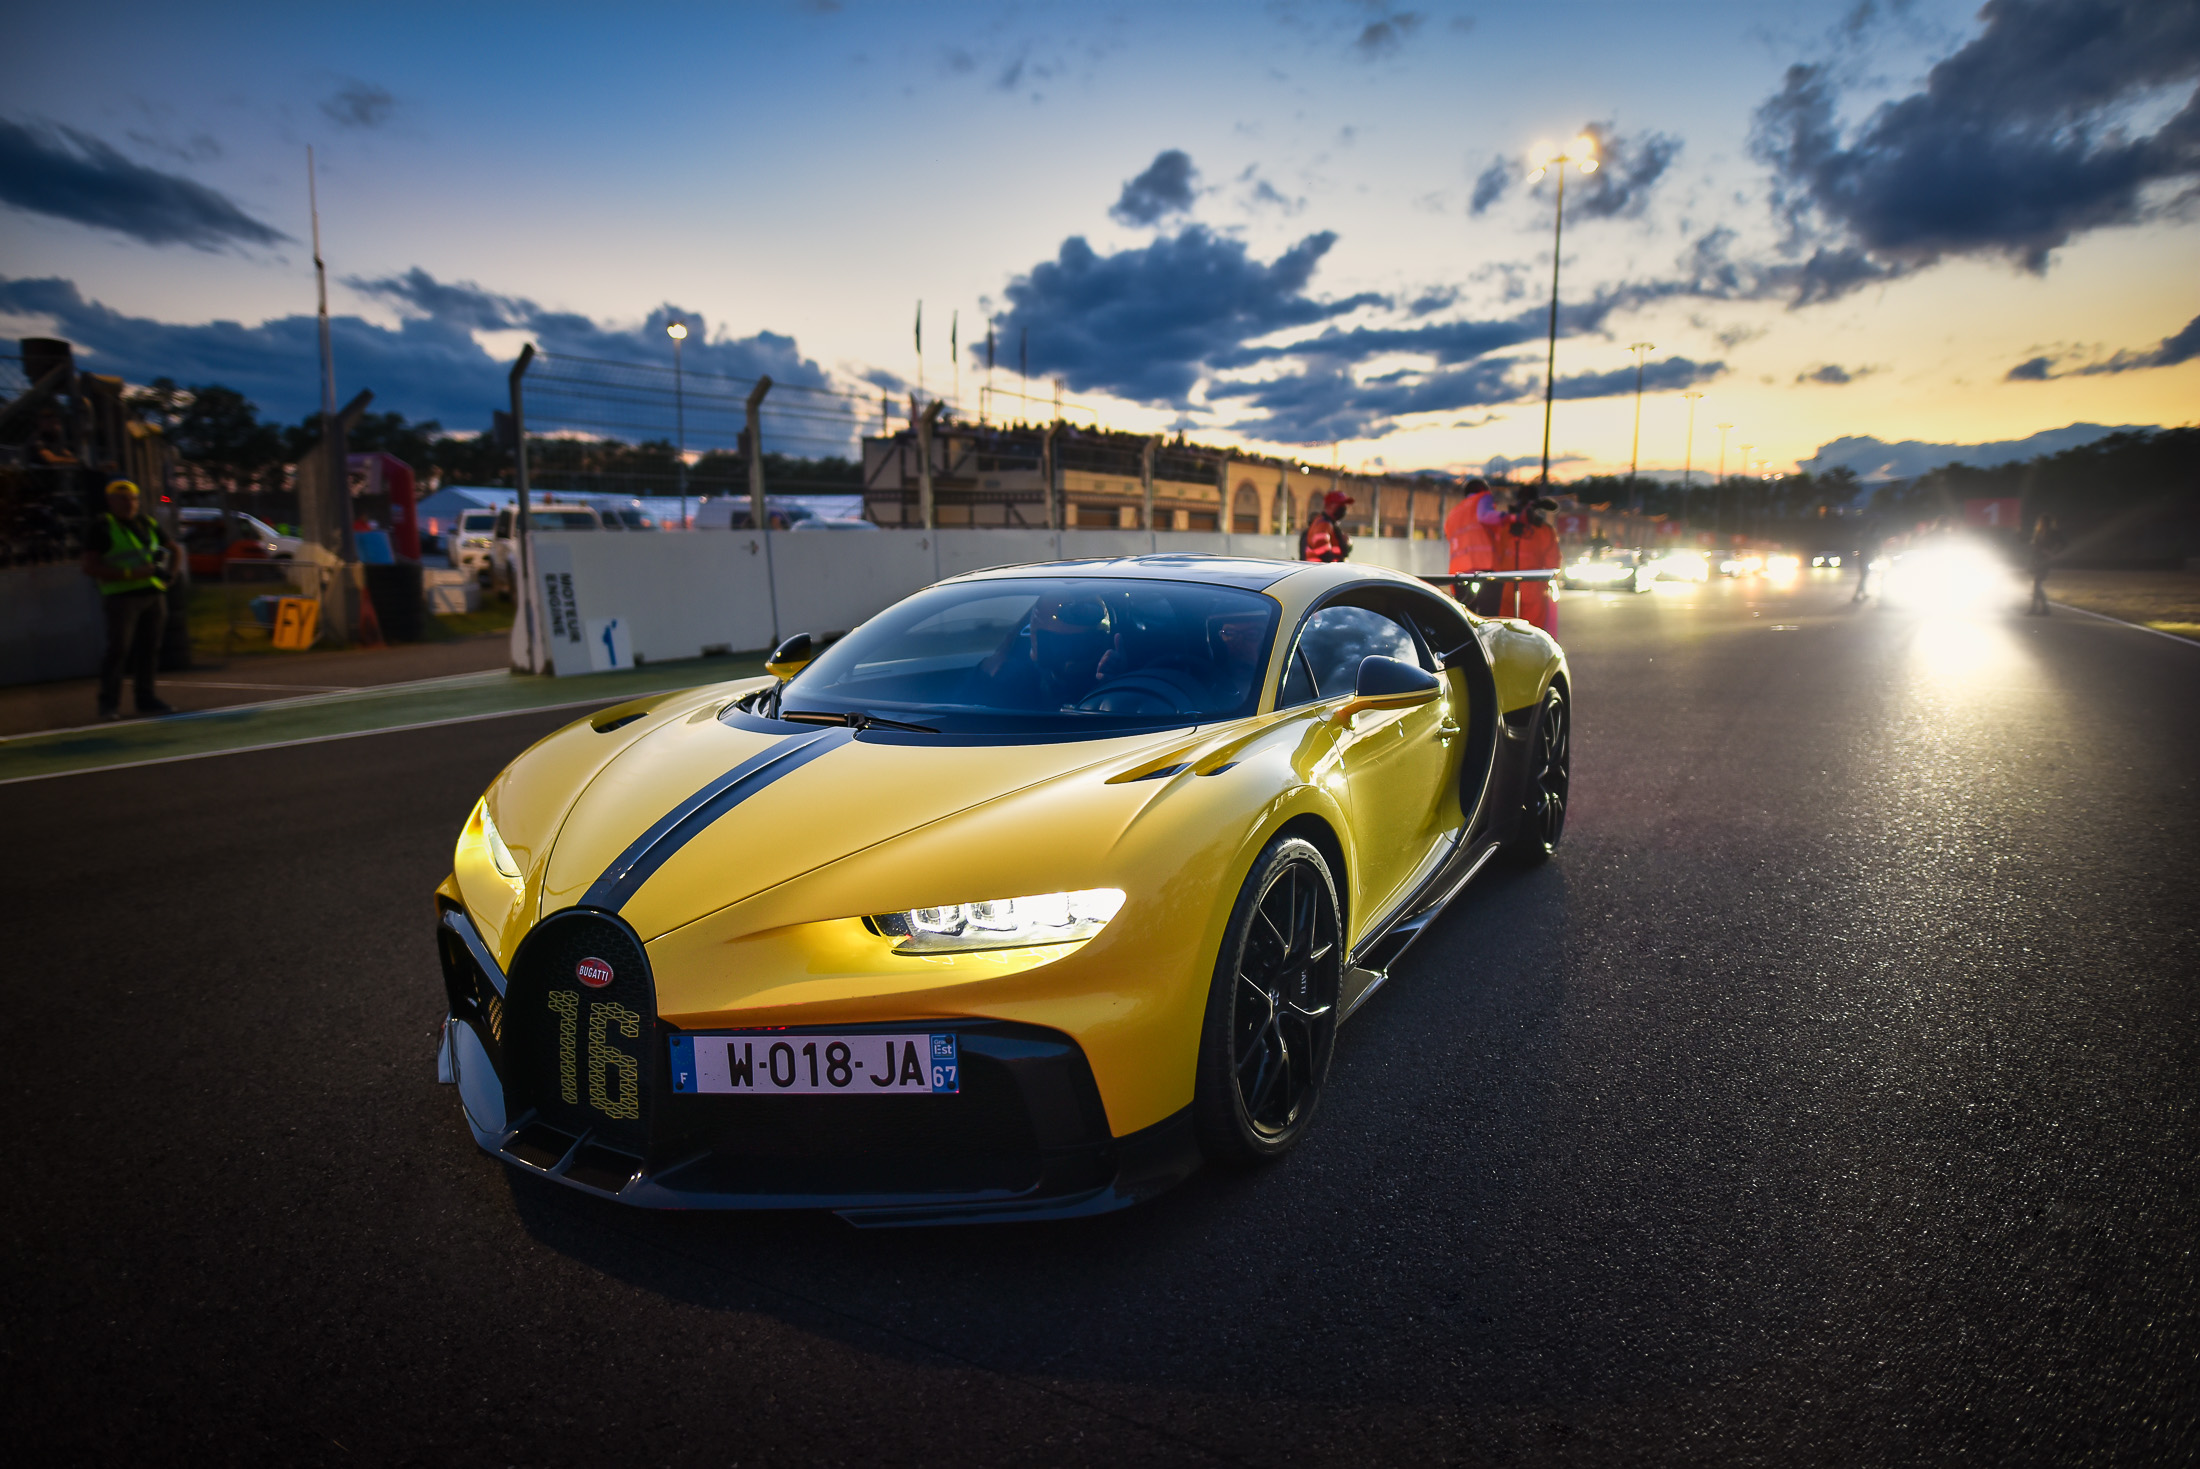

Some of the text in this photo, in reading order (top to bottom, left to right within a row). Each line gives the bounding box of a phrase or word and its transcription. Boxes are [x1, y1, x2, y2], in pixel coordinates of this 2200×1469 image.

[545, 573, 564, 636] ENGINE
[559, 573, 580, 642] MOTEUR
[579, 965, 608, 982] BUGATTI
[548, 990, 640, 1119] 16
[727, 1041, 925, 1088] W-018-JA
[934, 1044, 952, 1055] Est
[680, 1072, 688, 1084] F
[933, 1066, 956, 1087] 67
